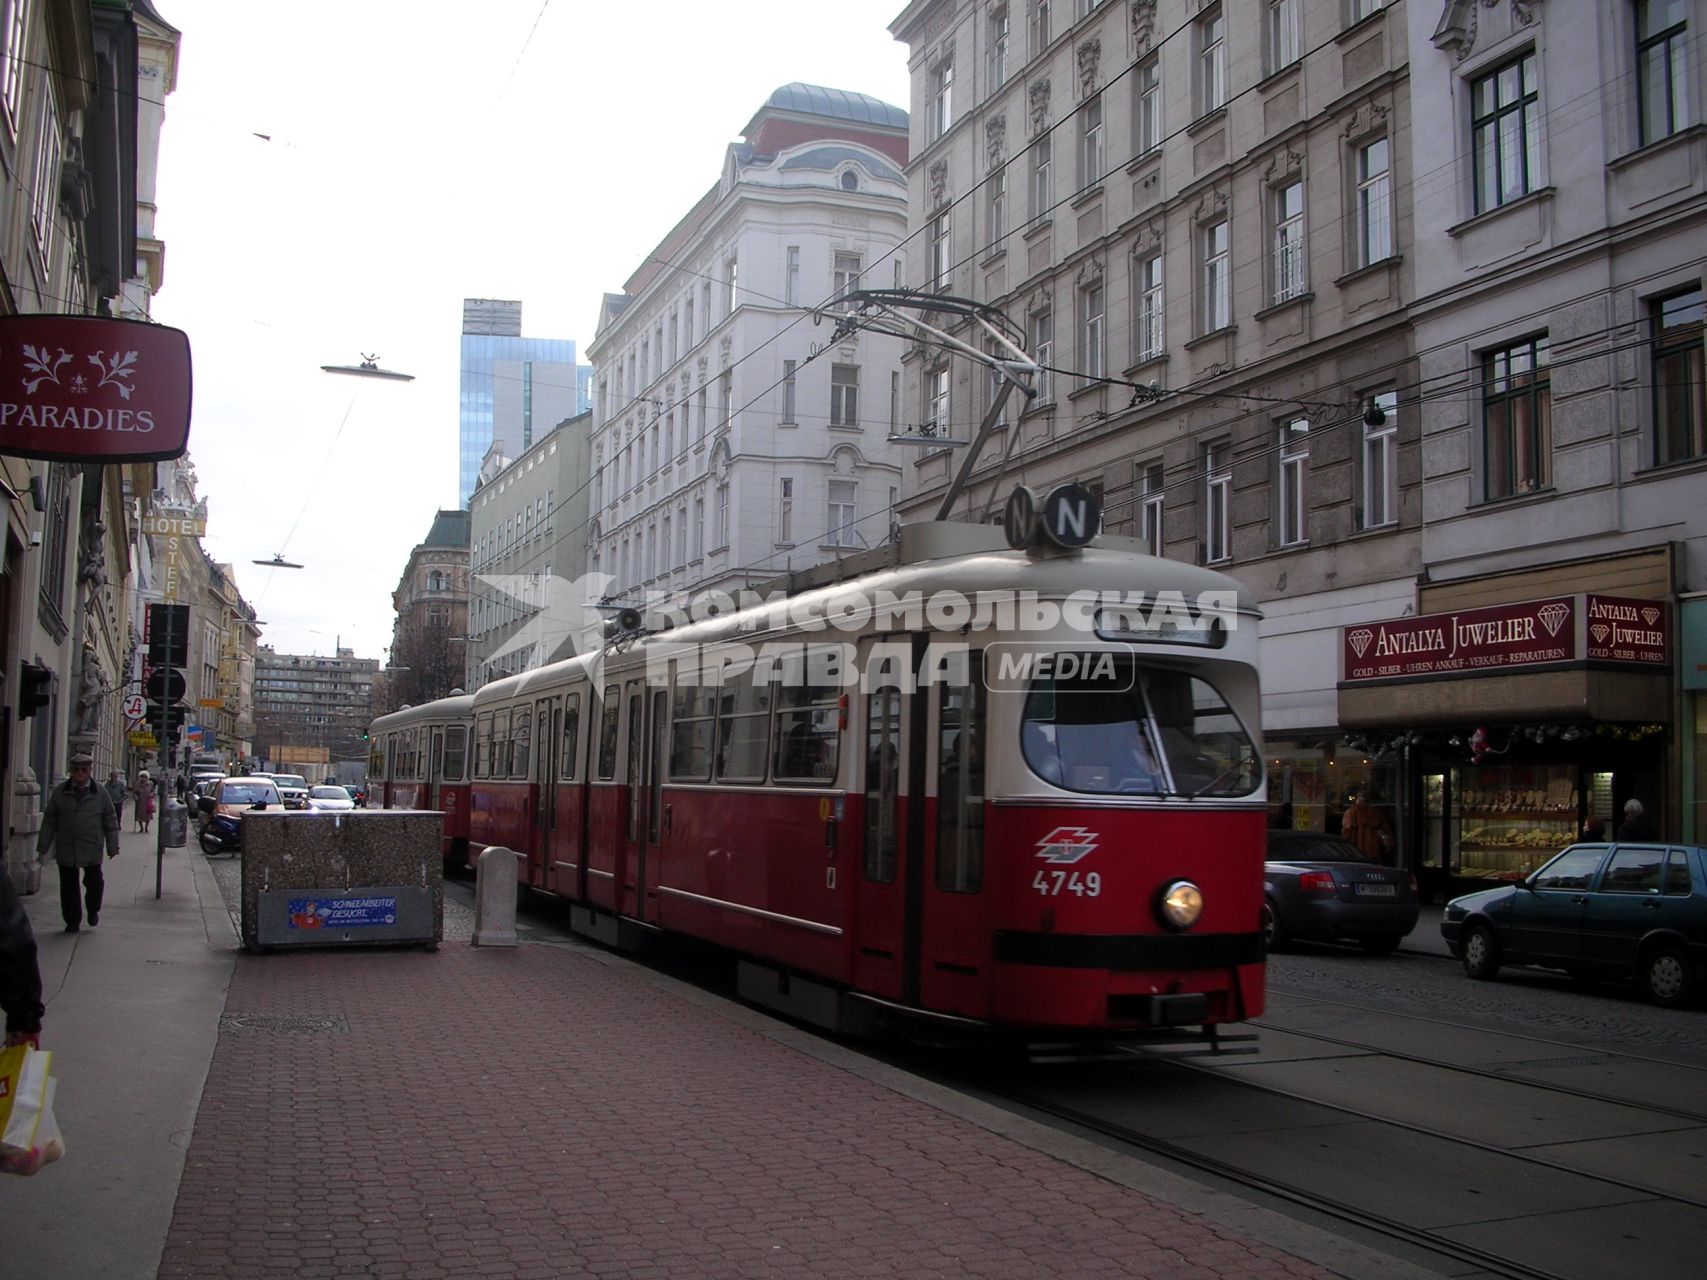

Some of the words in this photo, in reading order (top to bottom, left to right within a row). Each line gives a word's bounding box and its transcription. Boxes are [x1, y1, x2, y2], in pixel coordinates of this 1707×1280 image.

[0, 403, 155, 433] PARADIES
[143, 517, 203, 535] HOTEL
[1012, 495, 1026, 542] N
[1056, 497, 1087, 538] N
[1589, 597, 1638, 622] ANTALYA
[1375, 626, 1445, 657] ANTALYA
[1448, 616, 1536, 658] JUWELIER
[1609, 622, 1664, 648] JUWELIER
[1353, 667, 1374, 678] GOLD
[1378, 664, 1402, 675] SILBER
[1406, 661, 1433, 673] UHREN
[1434, 658, 1465, 670] ANKAUF
[1469, 655, 1504, 667] VERKAUF
[1509, 648, 1565, 663] REPARATUREN
[1588, 648, 1608, 657] GOLD
[1613, 650, 1635, 659] SILBER
[1640, 651, 1664, 661] UHREN
[1032, 870, 1101, 897] 4749
